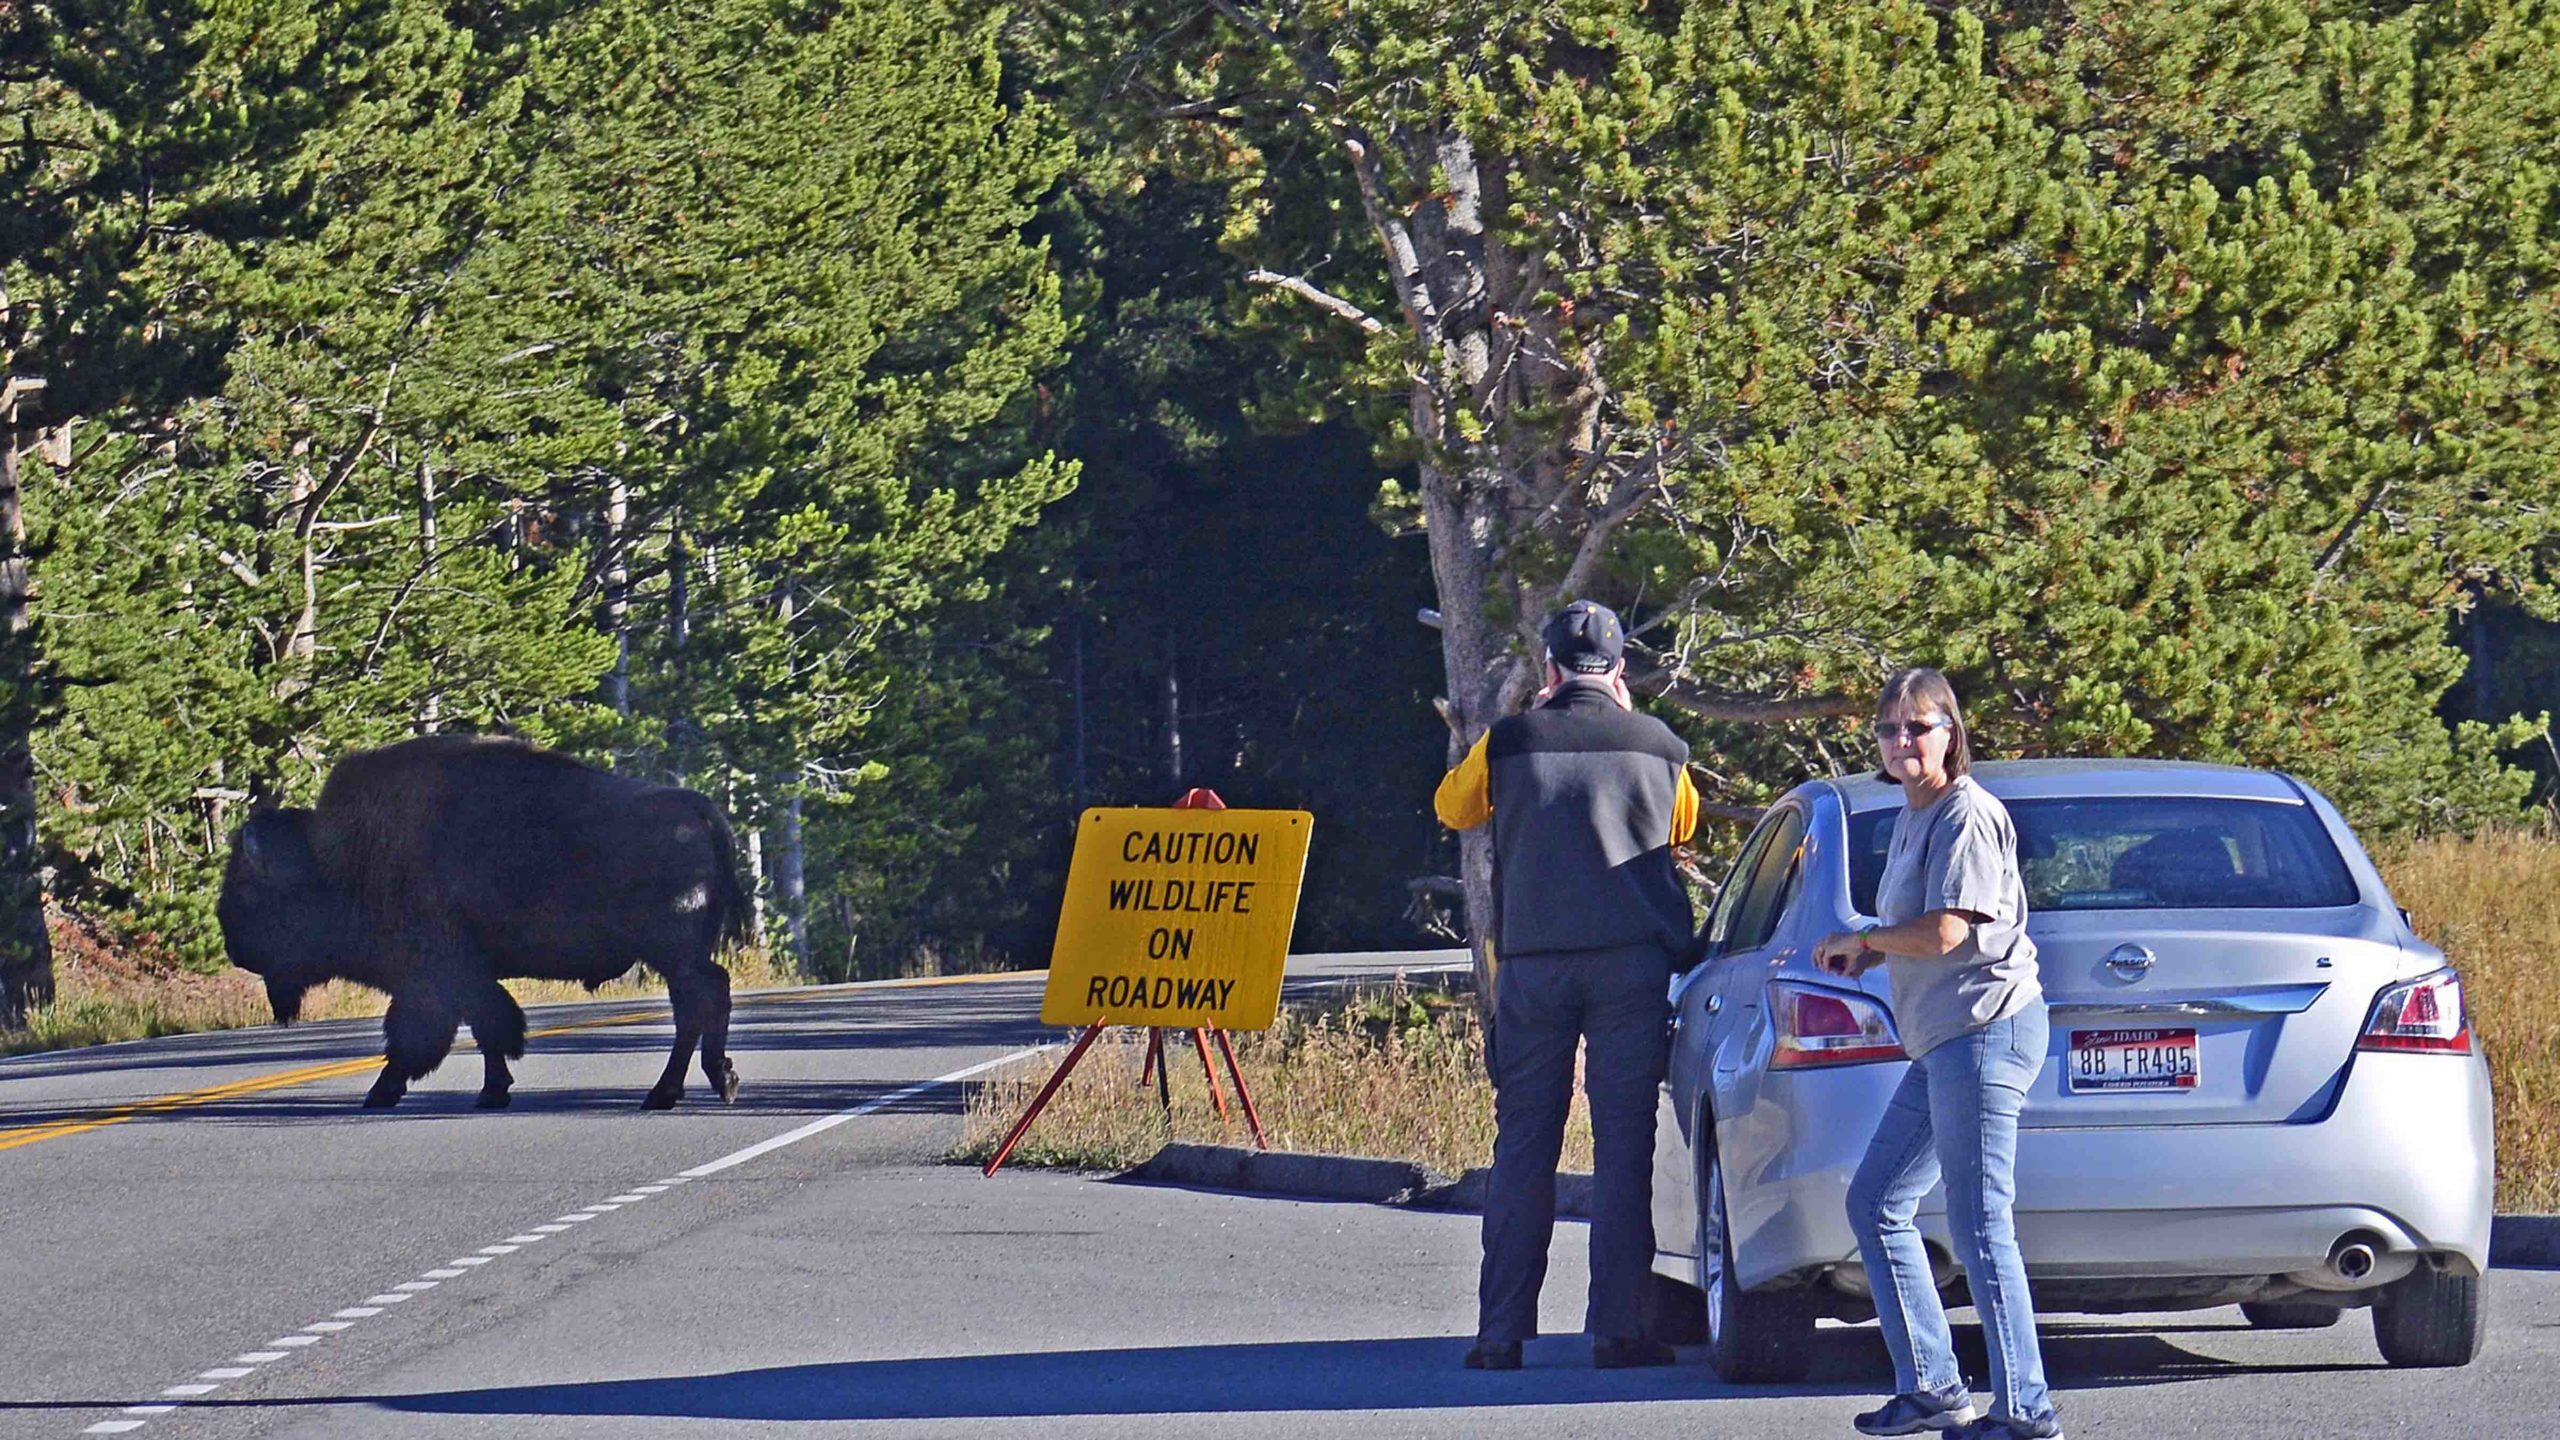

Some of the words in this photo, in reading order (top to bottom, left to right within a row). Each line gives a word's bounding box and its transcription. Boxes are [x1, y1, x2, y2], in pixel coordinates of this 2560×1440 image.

[1122, 831, 1259, 864] CAUTION
[1109, 880, 1256, 913] WILDLIFE
[1148, 928, 1193, 960] ON
[1086, 976, 1235, 1011] ROADWAY
[2113, 1030, 2158, 1042] IDAHO
[2080, 1048, 2106, 1076] 8B
[2123, 1046, 2192, 1075] FR495
